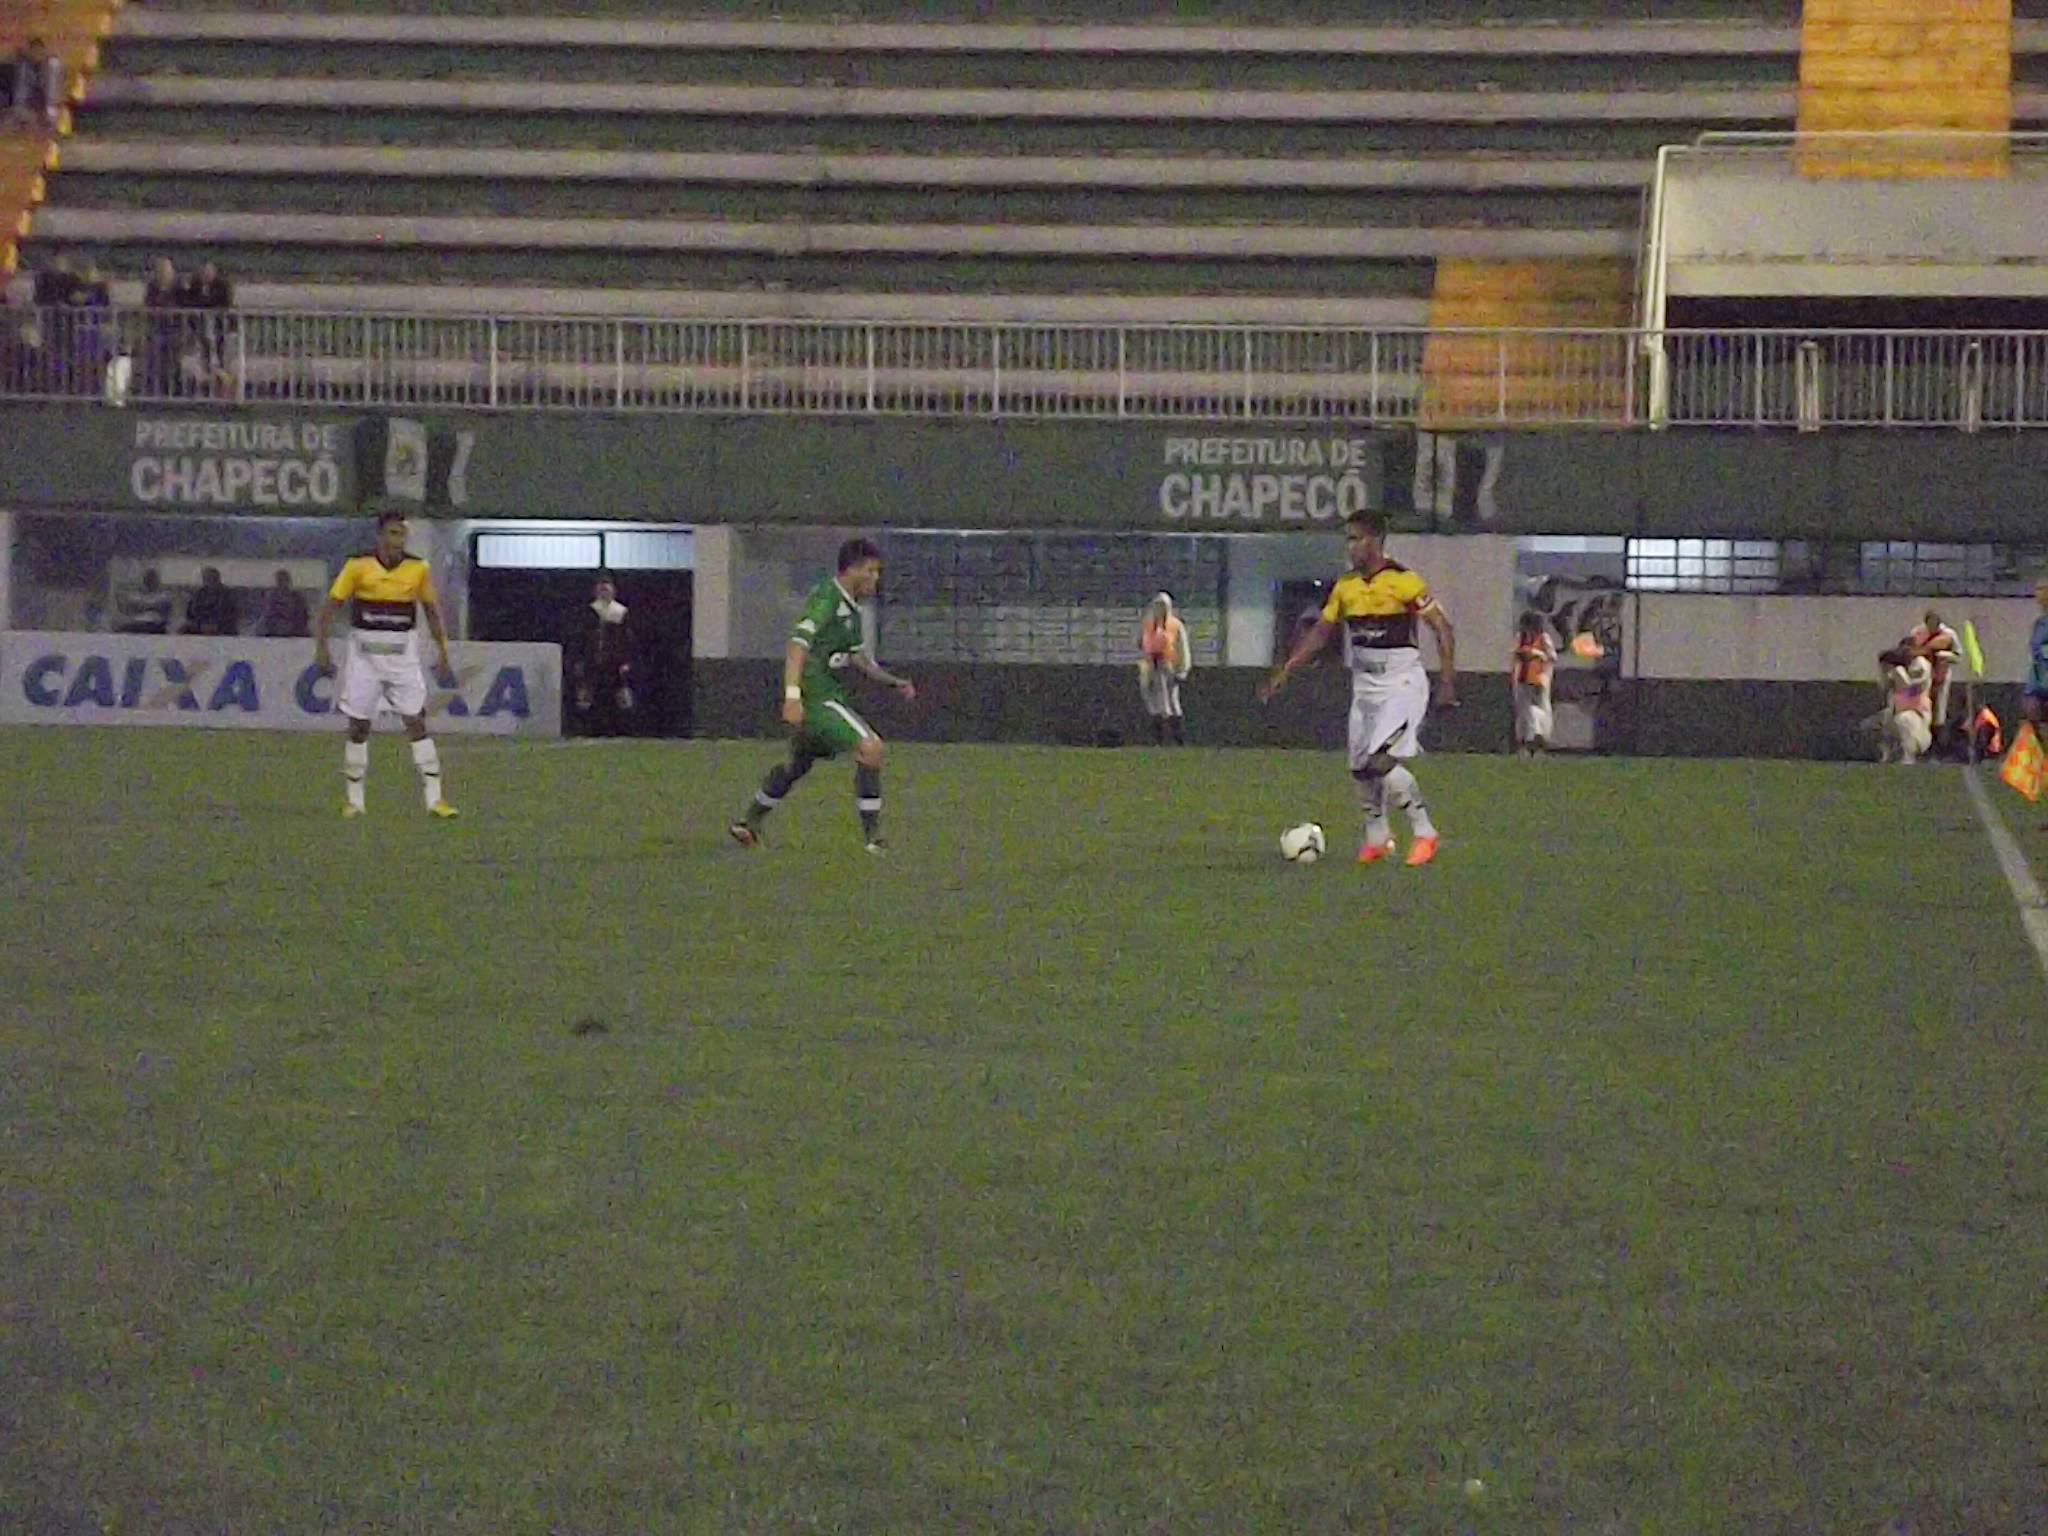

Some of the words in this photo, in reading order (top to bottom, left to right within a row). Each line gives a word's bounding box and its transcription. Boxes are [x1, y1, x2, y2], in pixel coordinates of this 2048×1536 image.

[135, 420, 295, 449] PREFEITURA
[302, 423, 338, 450] DE
[1164, 437, 1324, 466] PREFEITURA
[1331, 439, 1367, 467] DE
[23, 654, 259, 711] CAIXA
[295, 662, 530, 718] CXA
